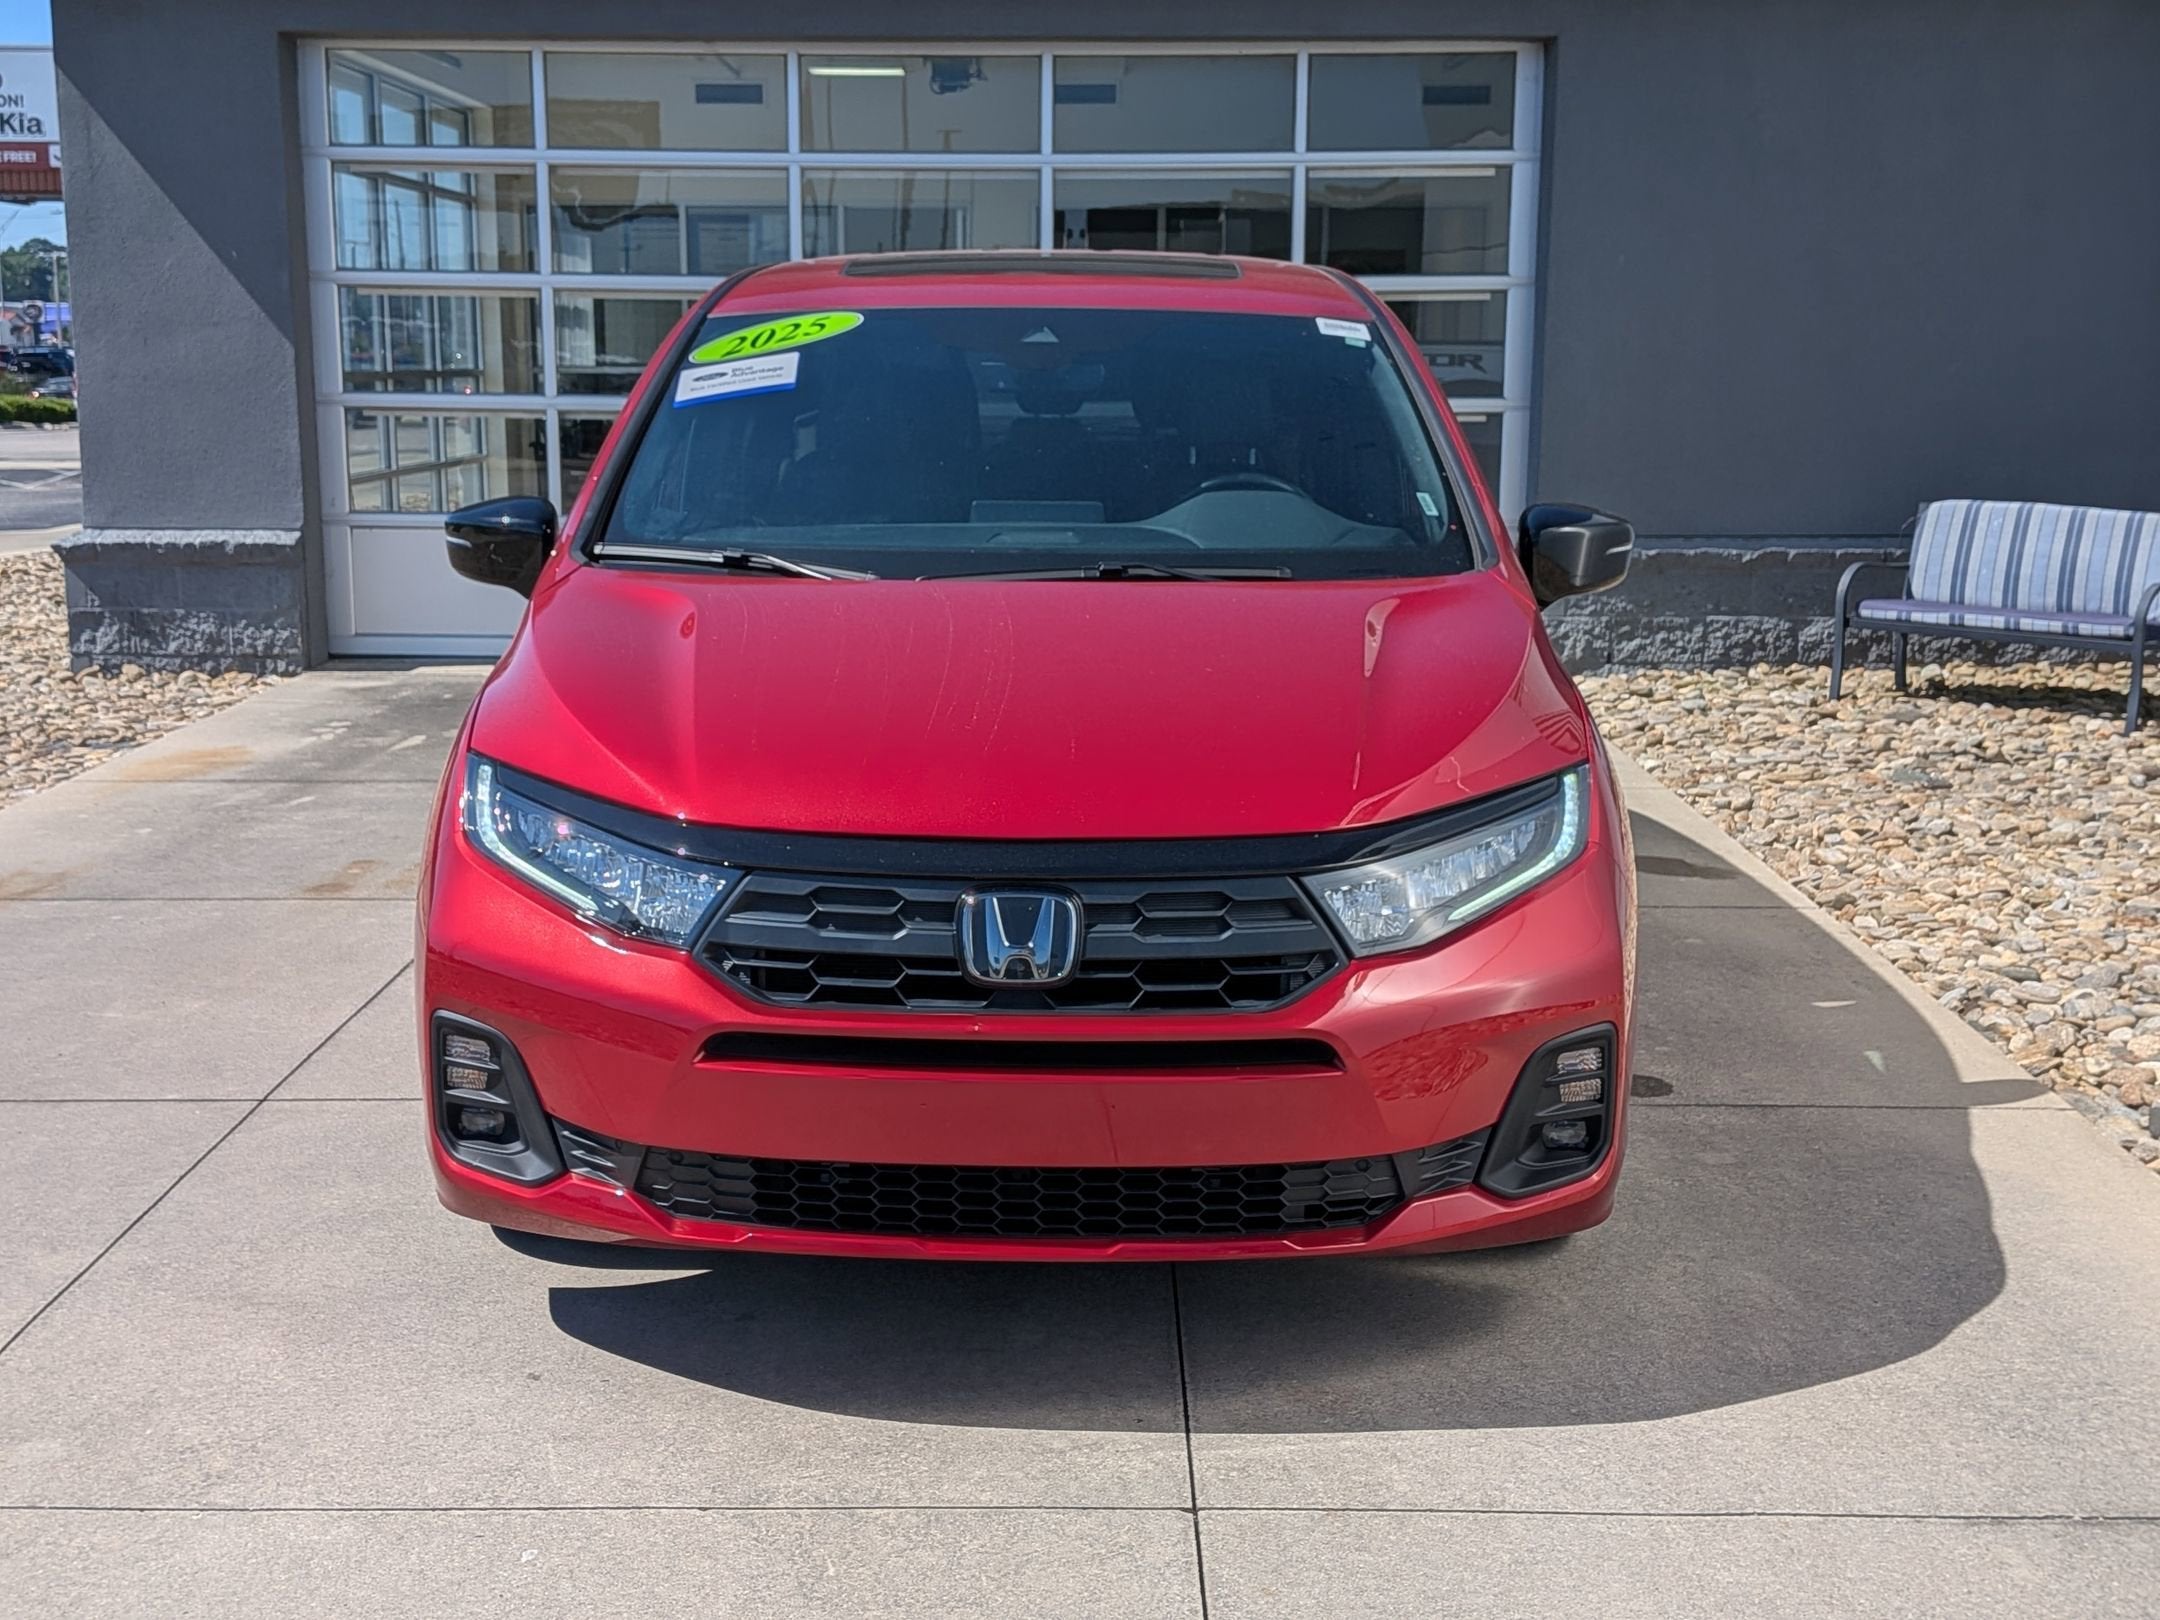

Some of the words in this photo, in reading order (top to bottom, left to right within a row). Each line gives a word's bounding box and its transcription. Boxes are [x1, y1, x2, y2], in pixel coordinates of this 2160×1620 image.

[0, 113, 43, 135] Kia
[3, 150, 37, 164] FREE!
[720, 316, 831, 358] 2025
[731, 366, 785, 377] Advantage
